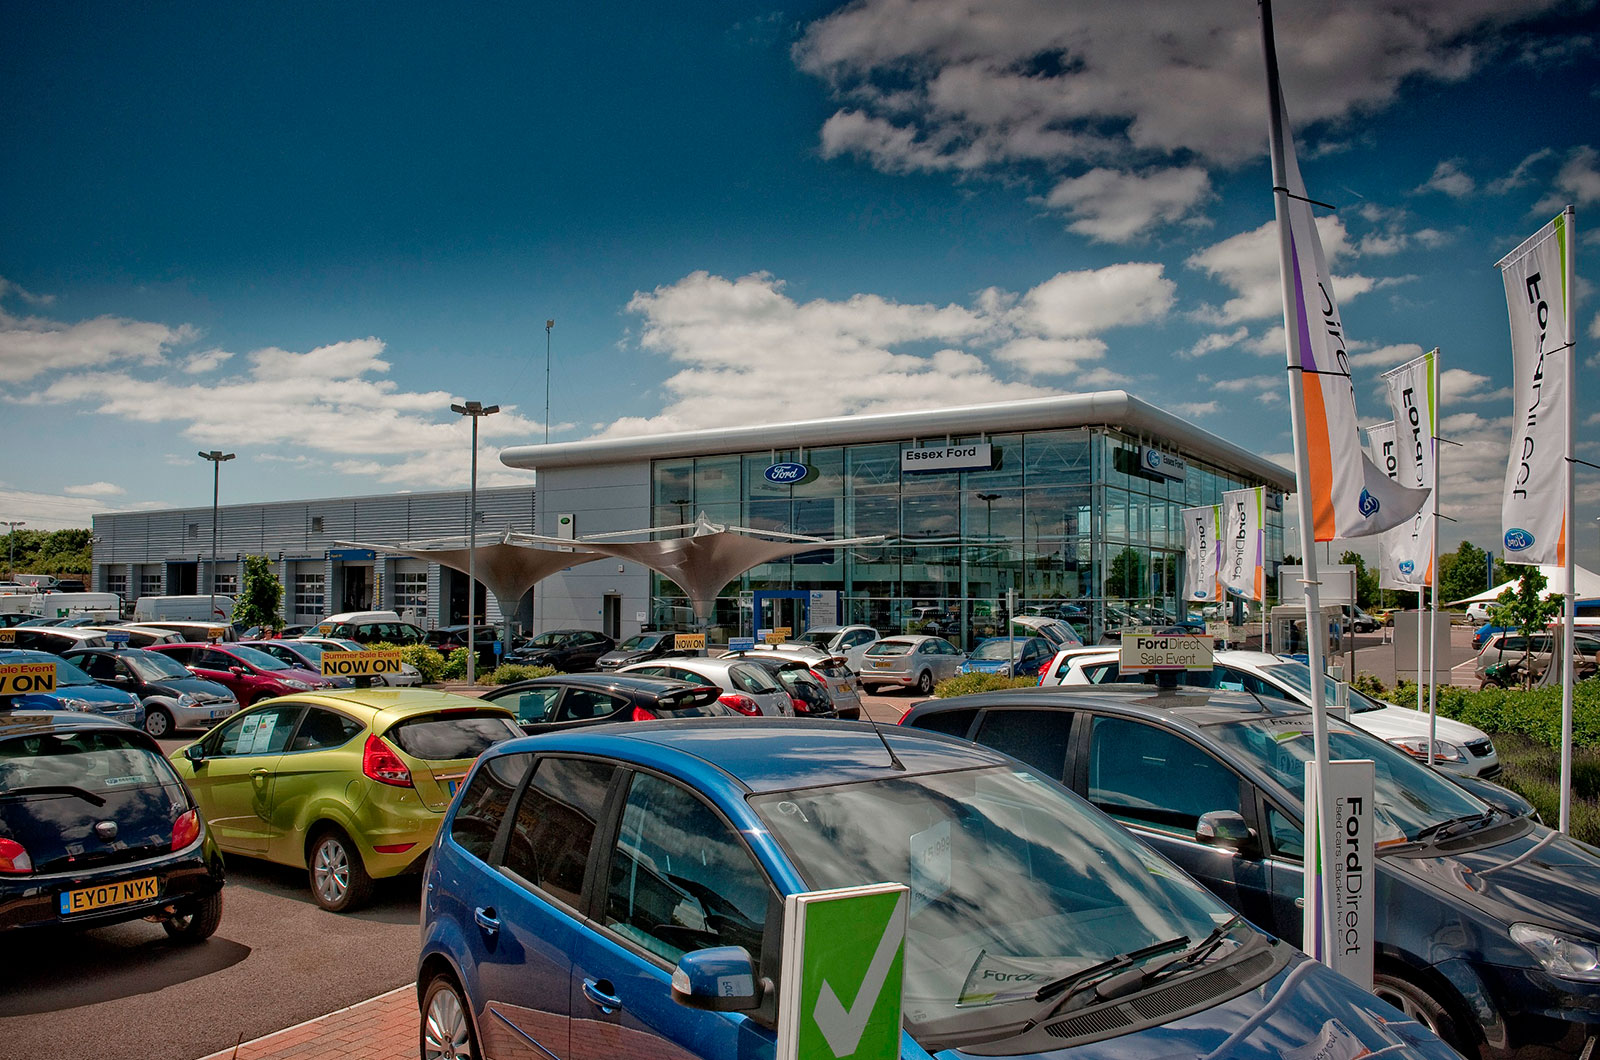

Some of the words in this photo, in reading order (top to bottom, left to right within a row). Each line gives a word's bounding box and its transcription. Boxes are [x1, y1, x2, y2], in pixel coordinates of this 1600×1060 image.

[906, 450, 943, 460] Essex
[946, 446, 976, 458] Ford
[771, 465, 798, 480] Ford
[676, 639, 692, 649] NOW
[693, 639, 705, 648] ON
[1137, 638, 1200, 650] FordDirect
[324, 652, 358, 660] Summer
[359, 651, 376, 659] Sale
[1140, 652, 1163, 665] Sale
[1166, 652, 1196, 665] Event
[0, 666, 18, 674] ale
[20, 664, 54, 673] Event
[324, 660, 369, 675] NOW
[372, 659, 399, 673] ON
[12, 674, 53, 692] ON
[1335, 797, 1343, 829] Used
[1345, 797, 1363, 956] FordDirect
[1335, 863, 1343, 909] Backed
[73, 886, 119, 909] EY07
[123, 879, 155, 900] NYK
